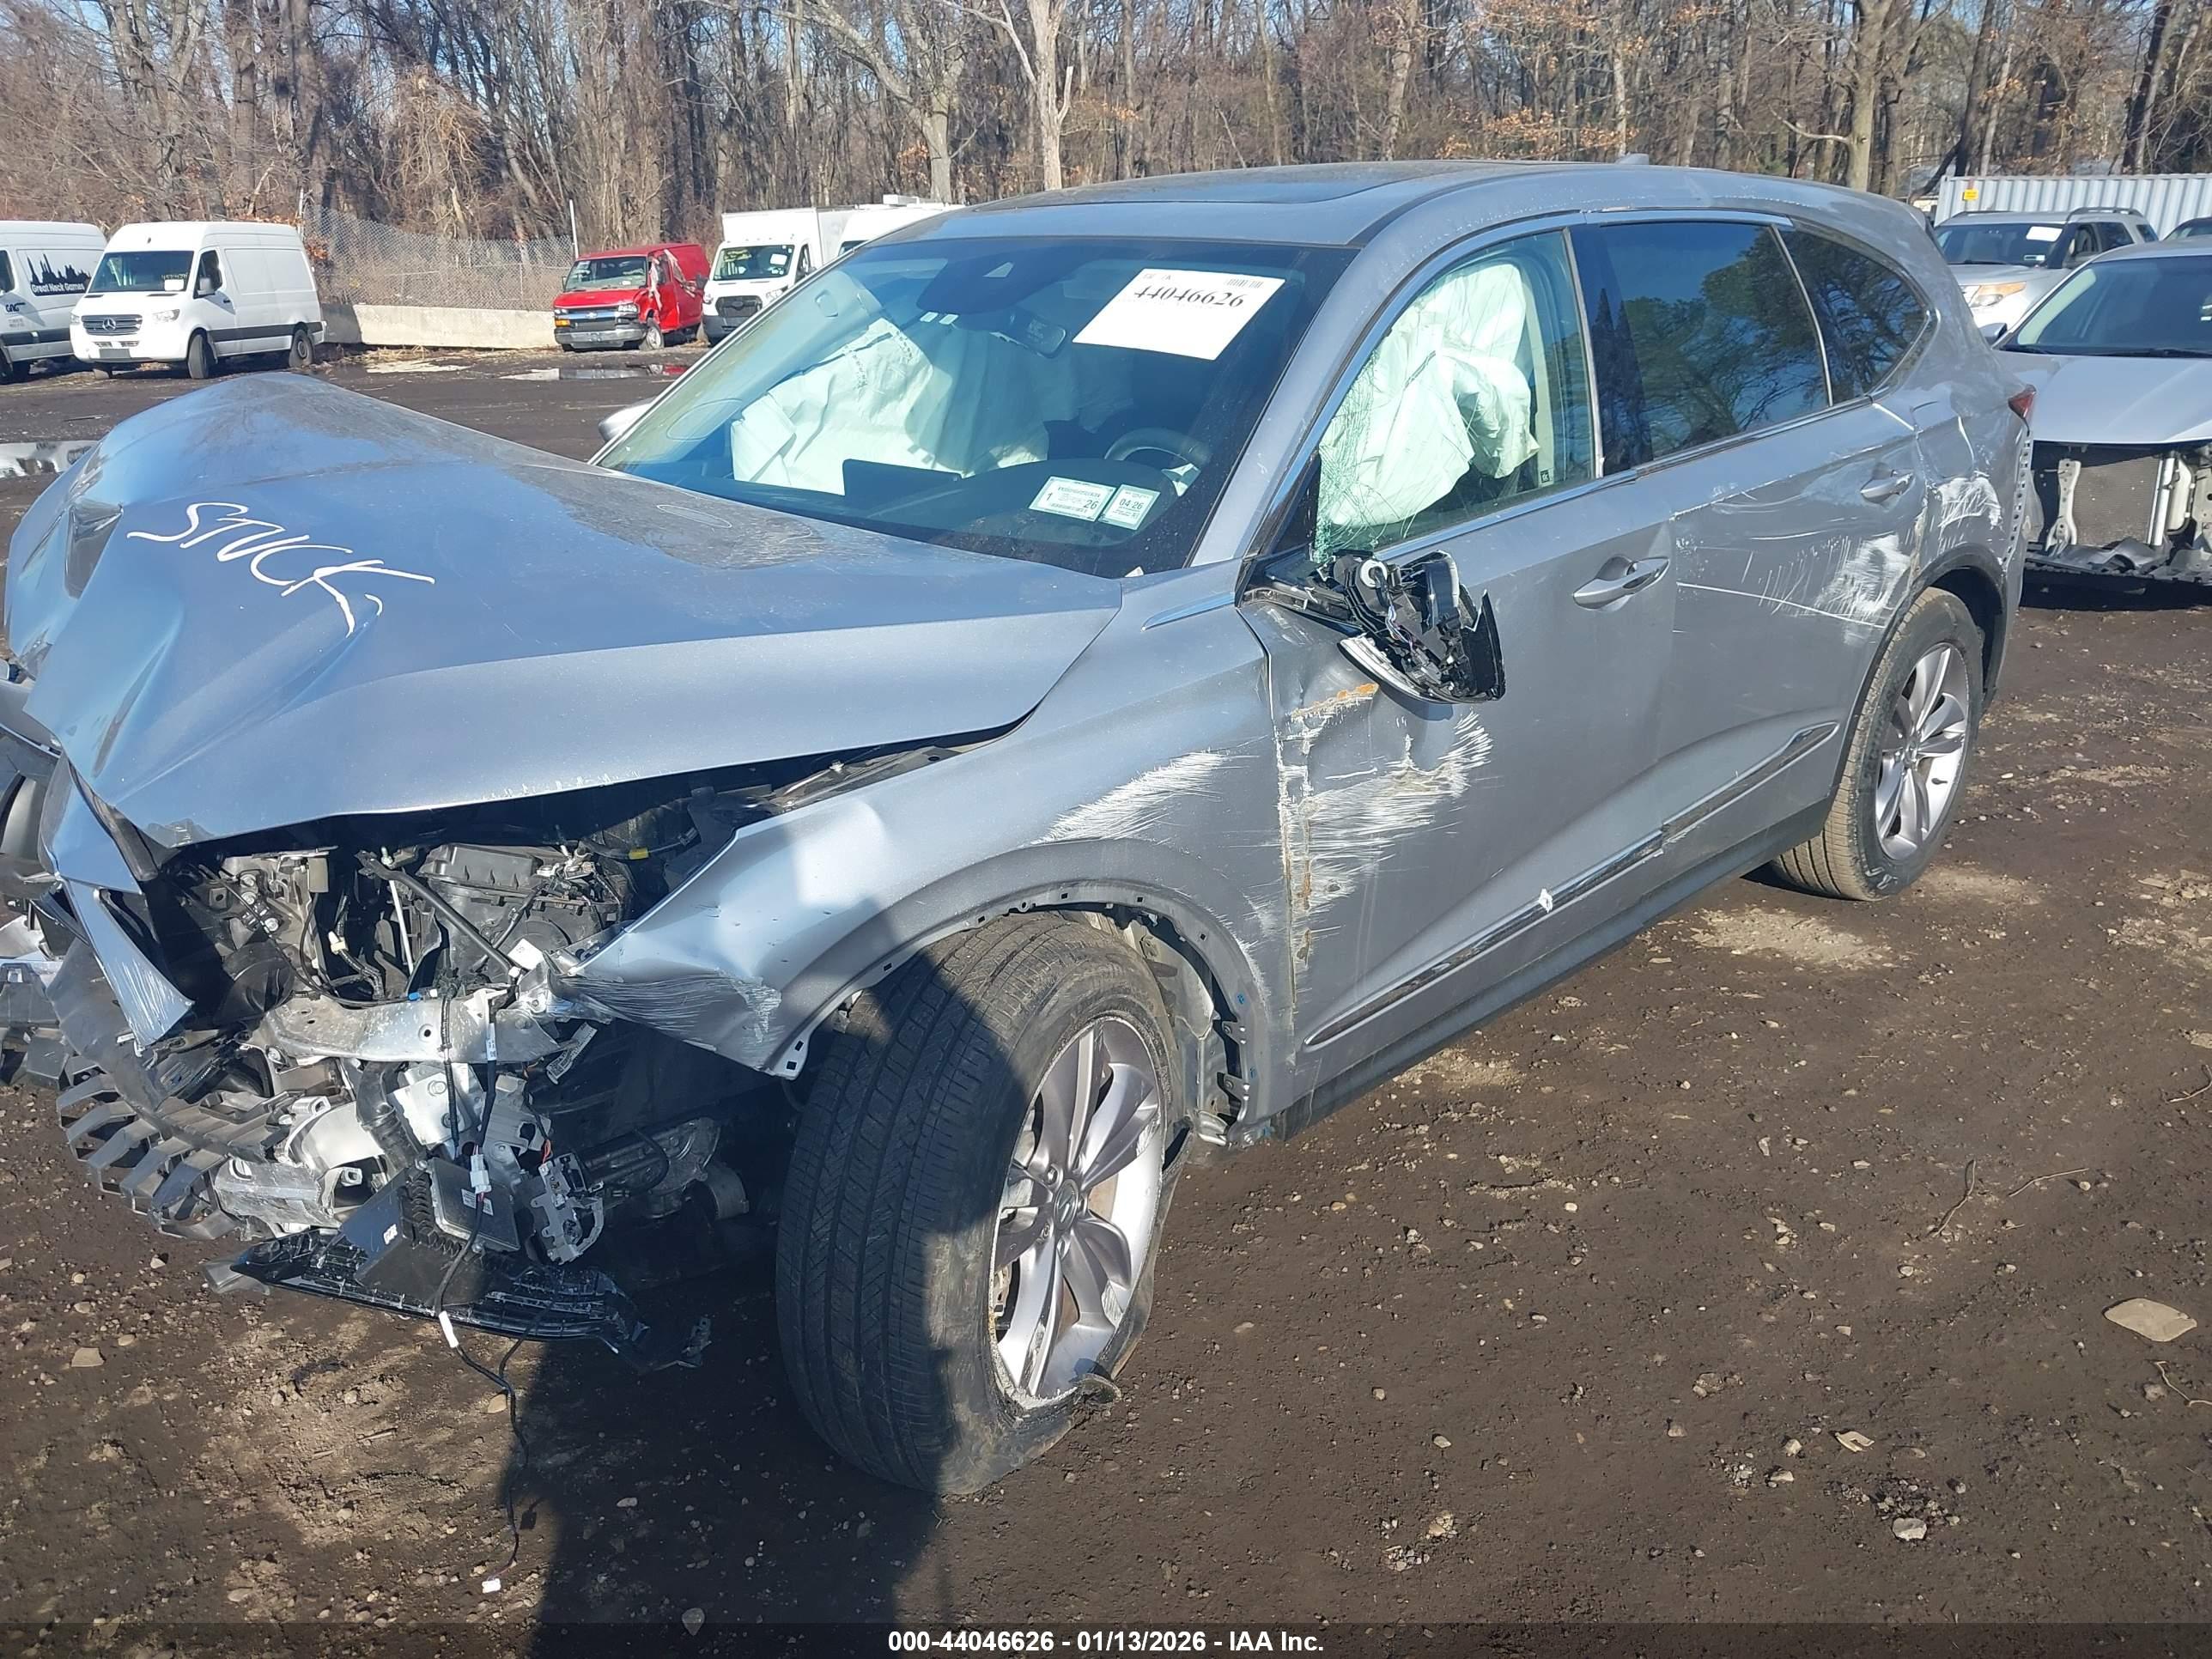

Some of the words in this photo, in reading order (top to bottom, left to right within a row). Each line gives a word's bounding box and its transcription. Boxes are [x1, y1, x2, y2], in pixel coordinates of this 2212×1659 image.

[32, 283, 49, 293] Great
[49, 283, 65, 292] Neck
[64, 283, 85, 291] Games
[1134, 286, 1248, 307] 44046626
[1083, 500, 1099, 509] 26
